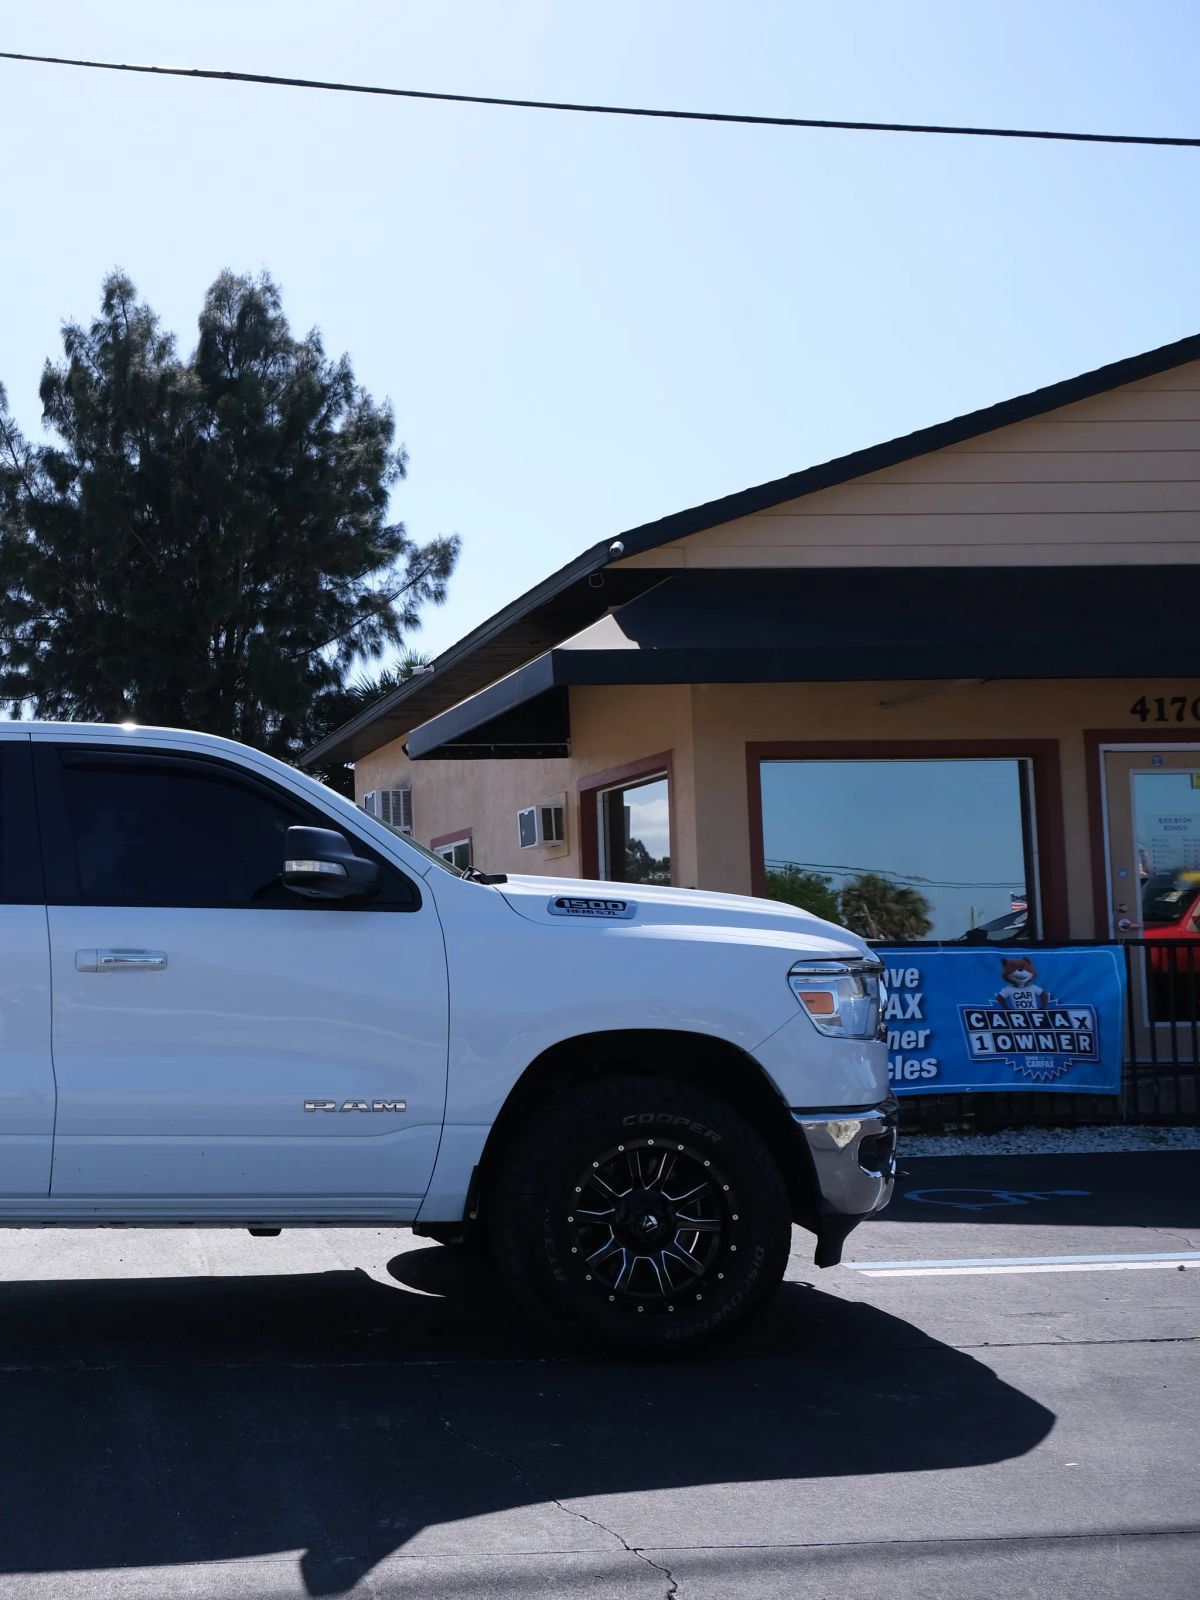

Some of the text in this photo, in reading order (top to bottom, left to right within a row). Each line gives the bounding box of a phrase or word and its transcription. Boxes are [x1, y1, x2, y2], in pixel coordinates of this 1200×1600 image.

[562, 899, 624, 912] 1500
[884, 967, 920, 988] ve
[1013, 991, 1033, 1000] CAR
[885, 993, 923, 1019] AX
[1016, 1000, 1034, 1009] FOX
[970, 1012, 1090, 1029] CARFAX
[1026, 1060, 1054, 1068] CARFAX
[304, 1100, 406, 1112] RAM
[623, 1113, 722, 1142] COOPER
